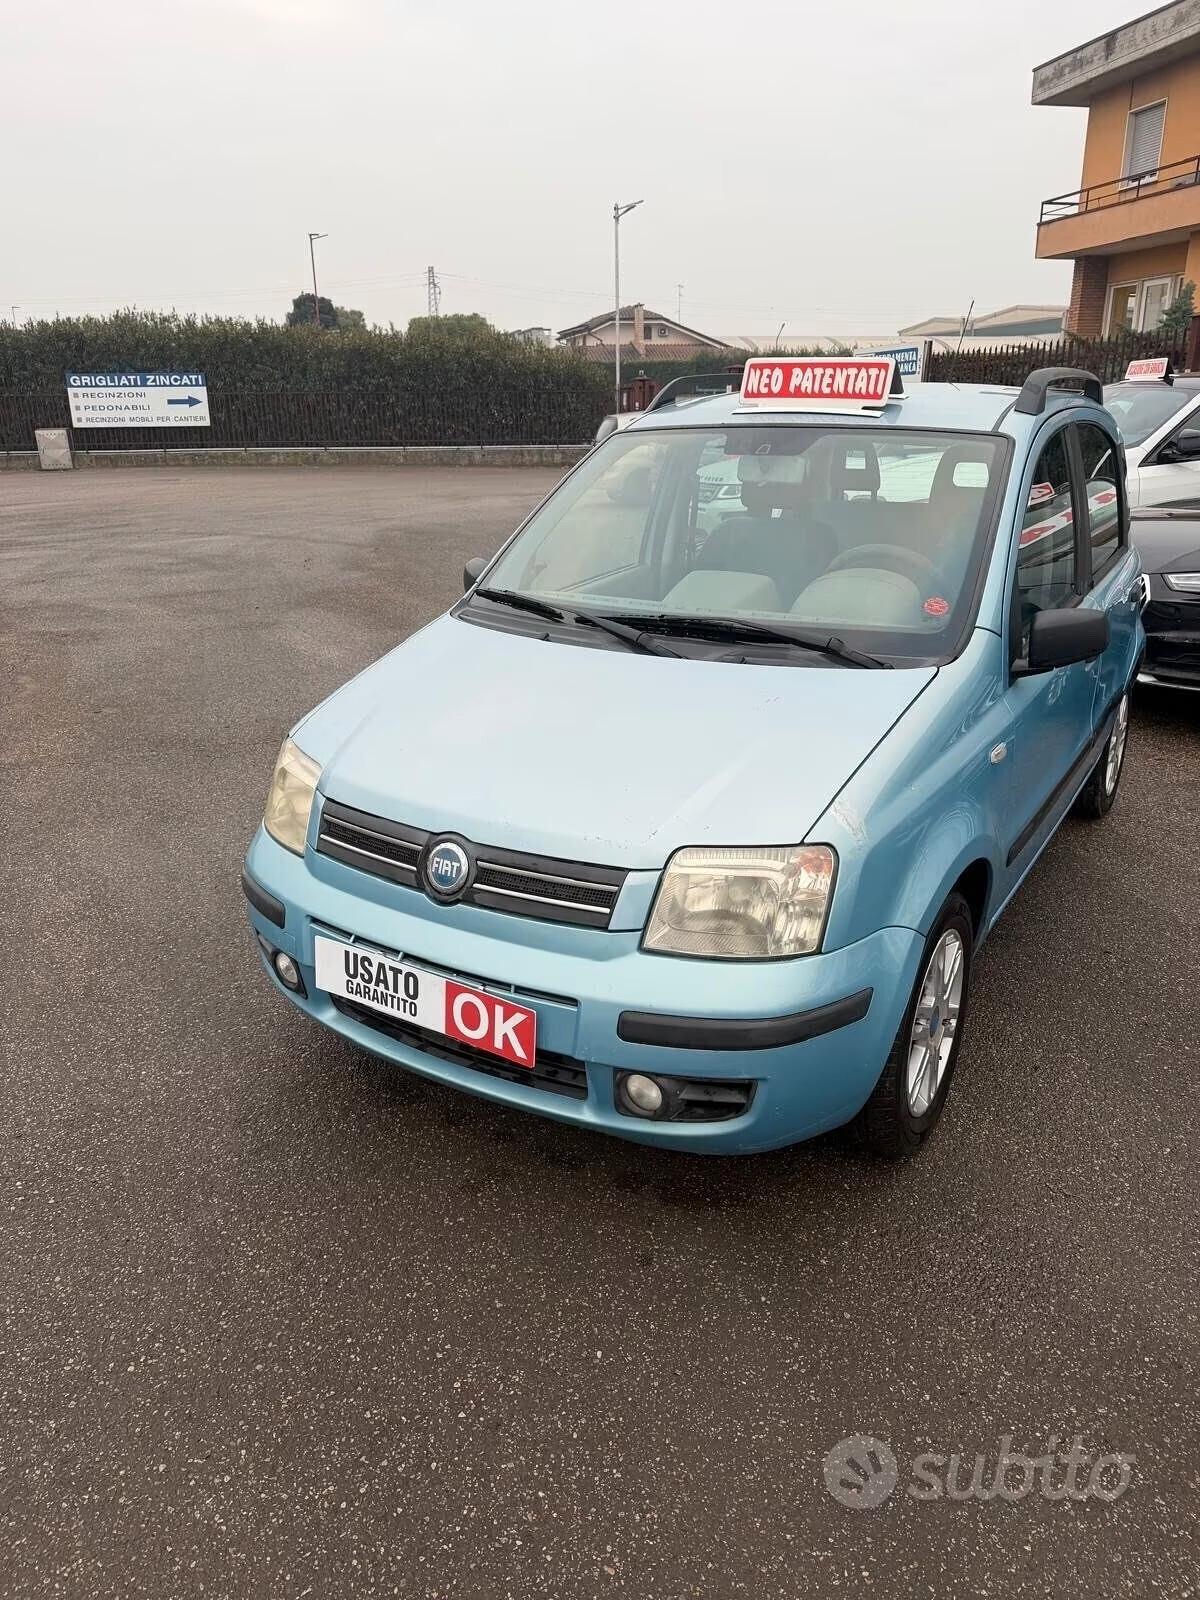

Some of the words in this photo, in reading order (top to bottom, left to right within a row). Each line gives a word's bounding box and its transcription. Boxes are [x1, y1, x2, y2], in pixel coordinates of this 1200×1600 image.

[69, 375, 141, 386] GRIGLIATI
[146, 374, 202, 386] ZINCATI
[747, 367, 783, 394] NEO
[790, 367, 886, 395] PATENTATI
[431, 857, 460, 878] FIAT
[344, 950, 419, 1001] USATO
[345, 980, 418, 1017] GARANTITO
[452, 992, 528, 1060] OK
